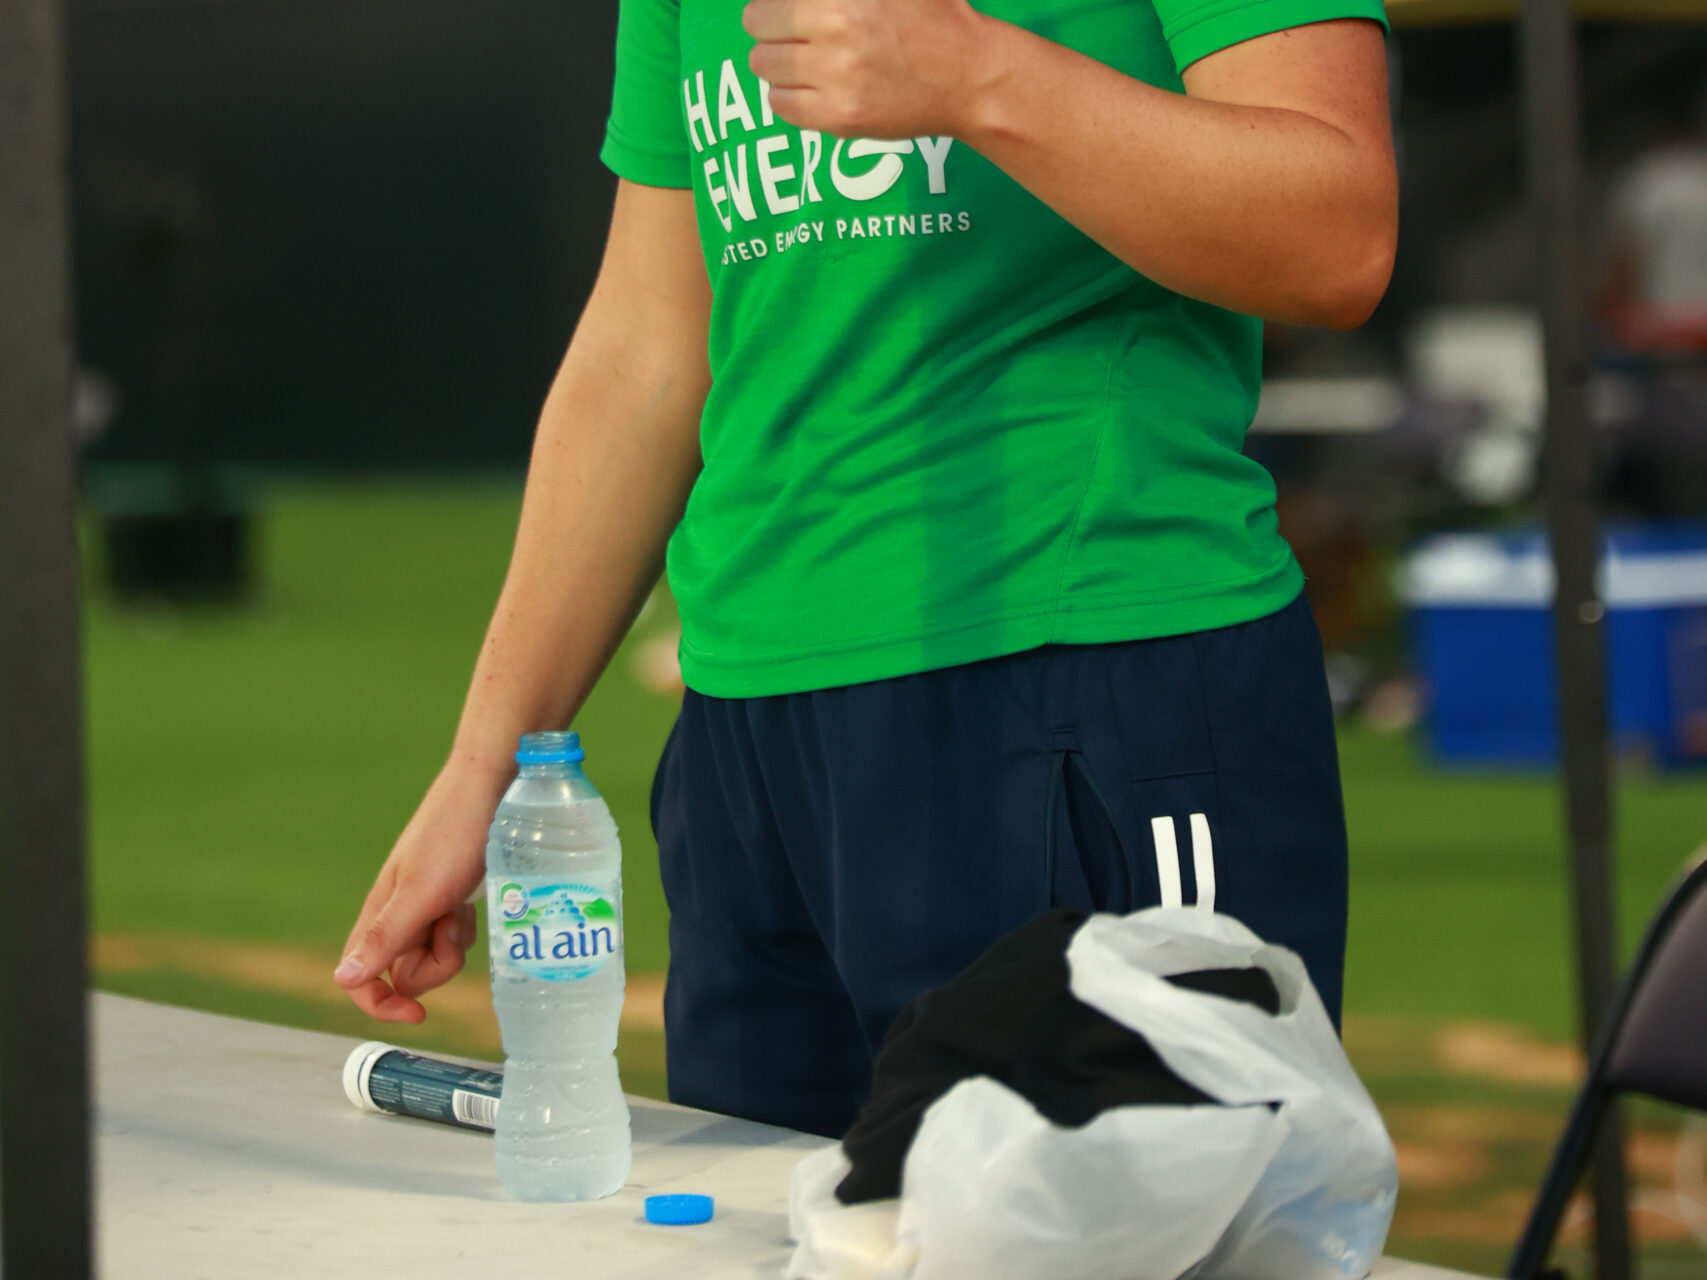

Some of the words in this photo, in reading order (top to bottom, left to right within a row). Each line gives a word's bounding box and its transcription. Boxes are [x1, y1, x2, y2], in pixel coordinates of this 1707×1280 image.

[836, 211, 971, 240] PARTNERS
[510, 925, 545, 960] al
[552, 922, 615, 959] ain
